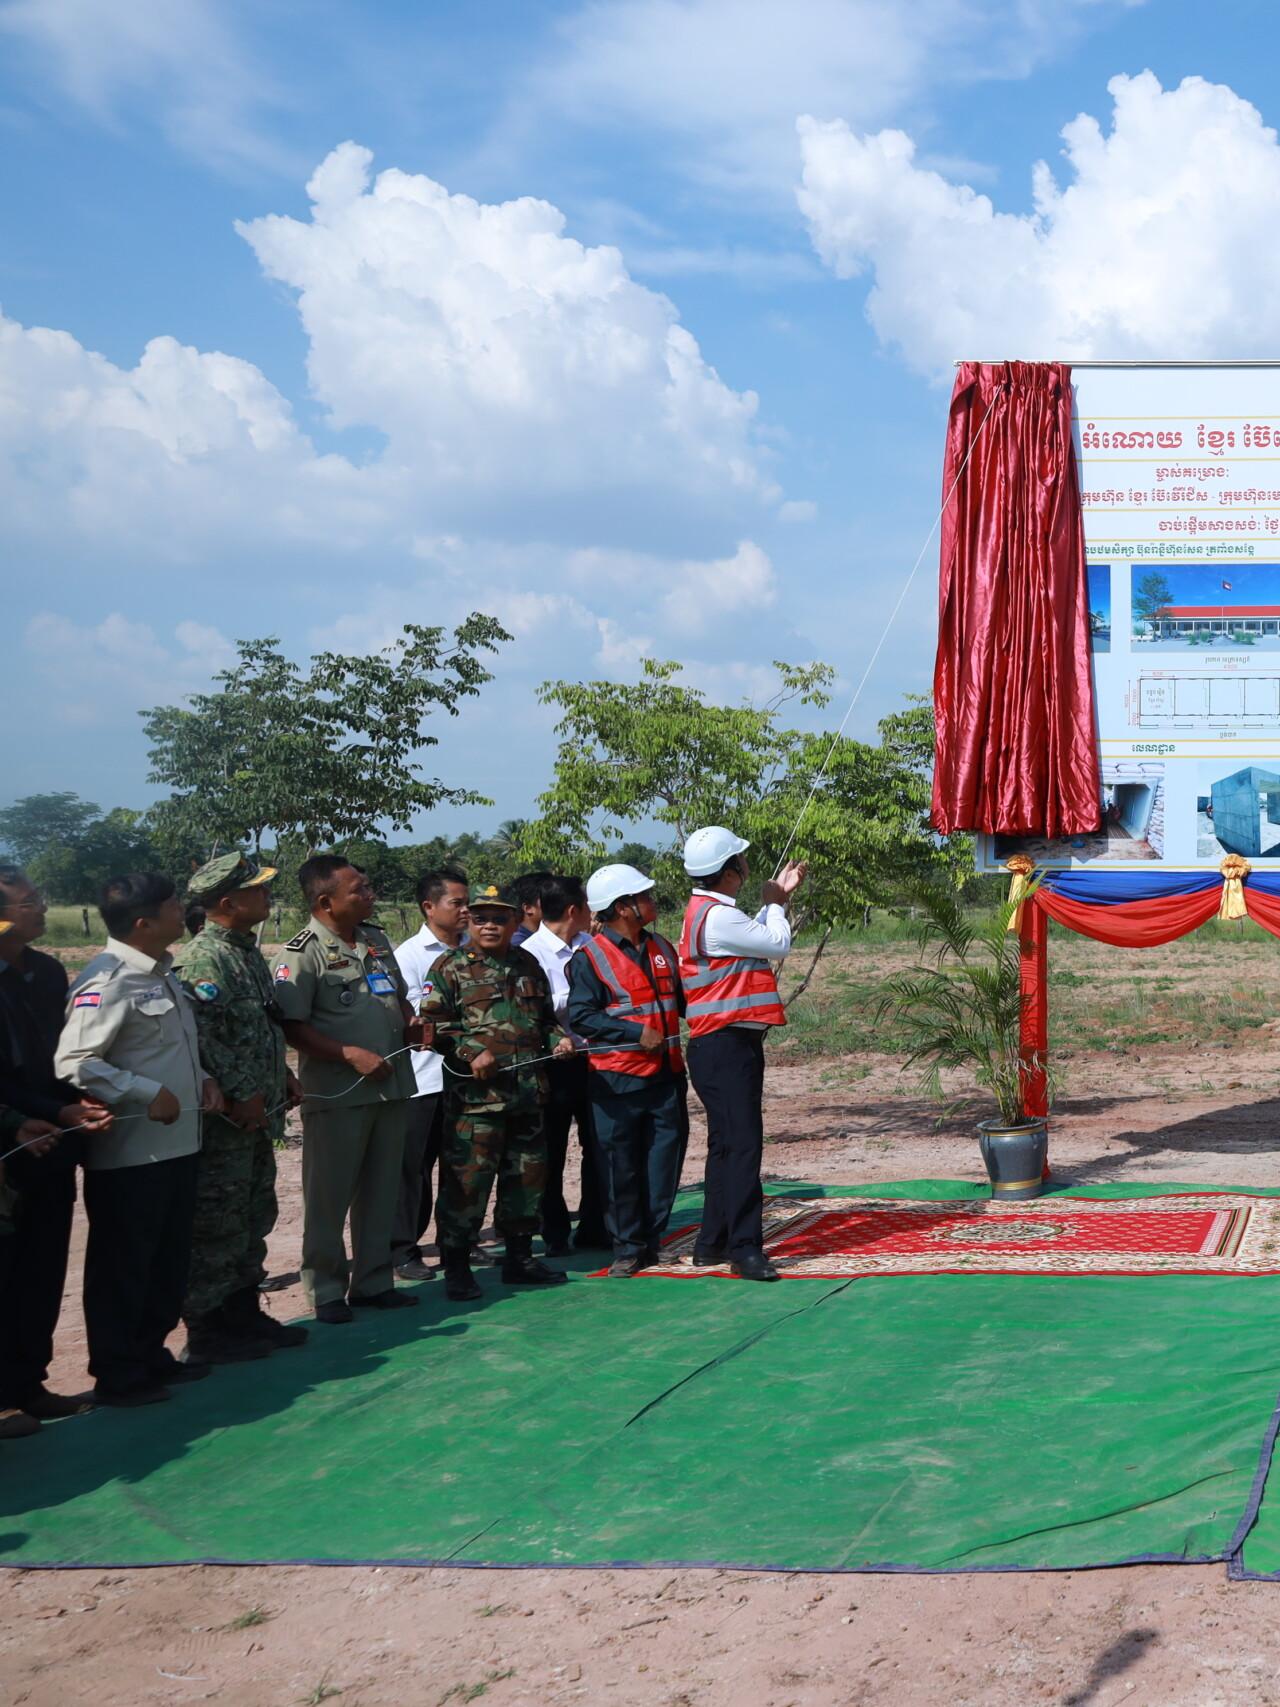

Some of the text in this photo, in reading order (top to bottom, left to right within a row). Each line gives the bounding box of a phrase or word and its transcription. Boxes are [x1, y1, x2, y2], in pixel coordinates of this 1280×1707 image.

[1082, 423, 1183, 449] អំណោយ
[1196, 423, 1236, 455] ខ្មែរ
[1128, 487, 1148, 505] ខ្មែរ
